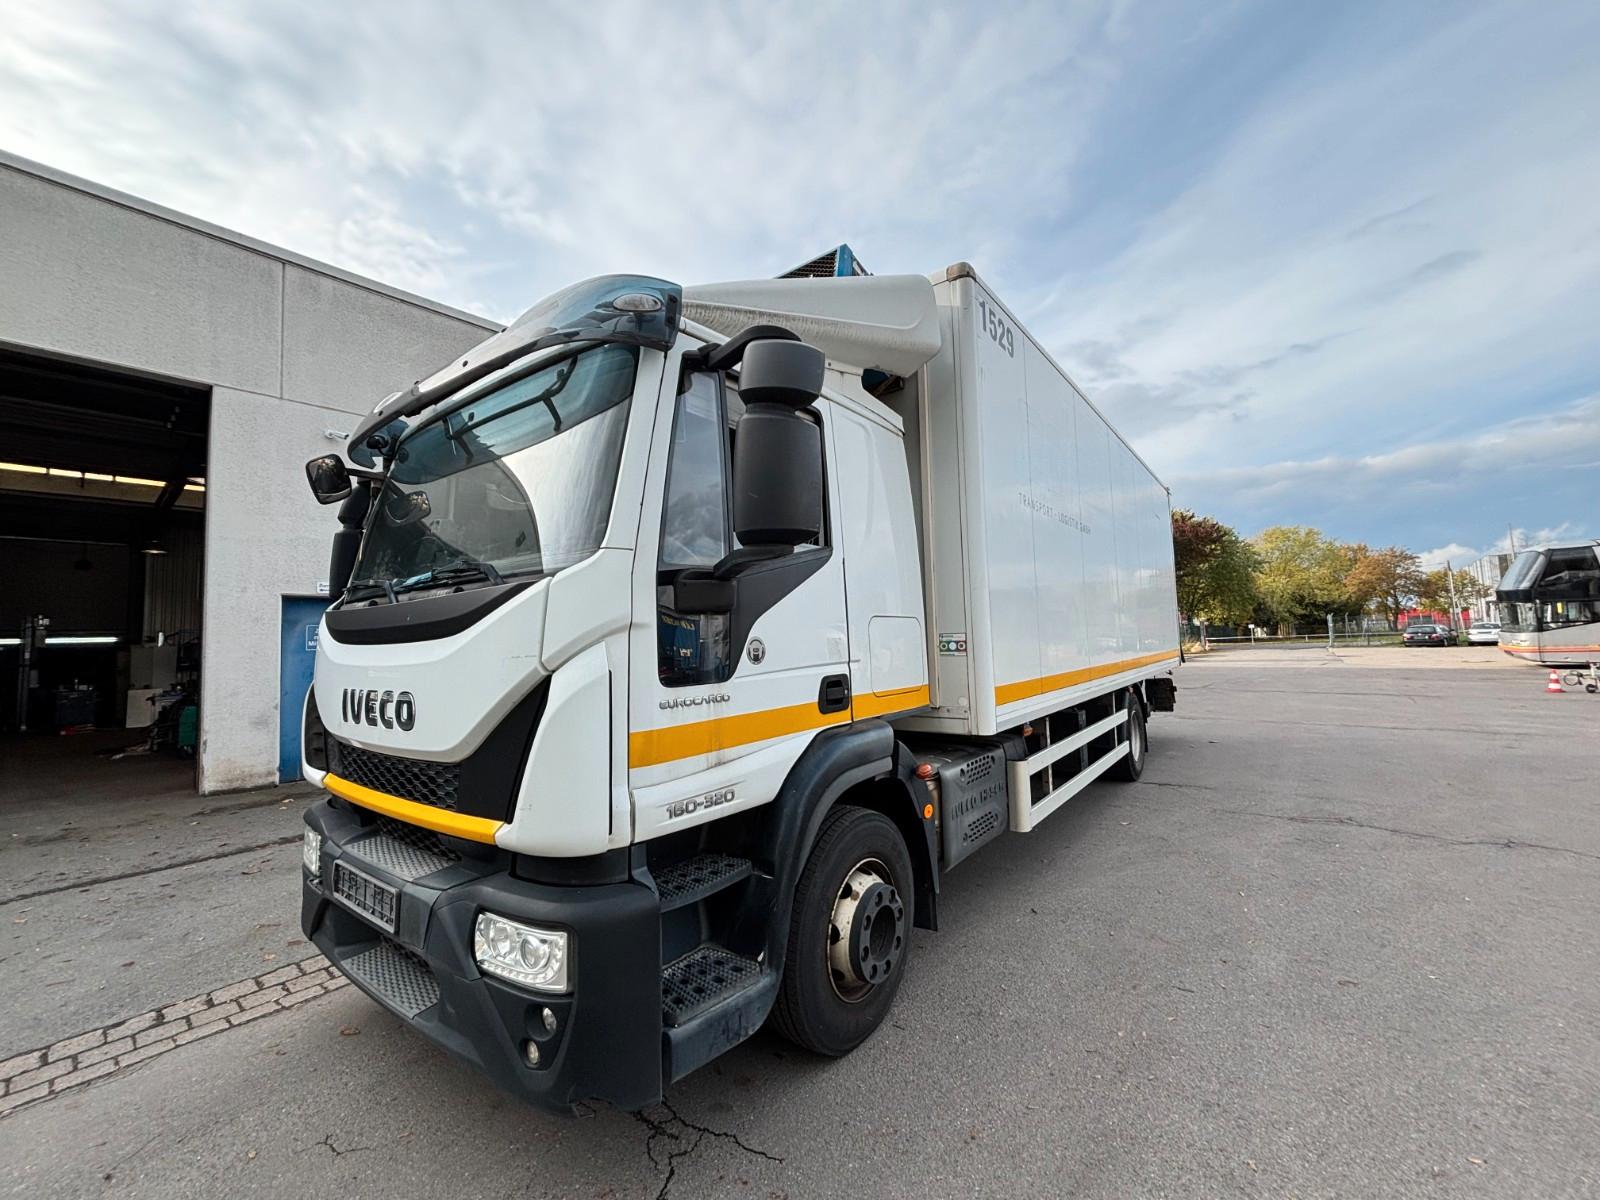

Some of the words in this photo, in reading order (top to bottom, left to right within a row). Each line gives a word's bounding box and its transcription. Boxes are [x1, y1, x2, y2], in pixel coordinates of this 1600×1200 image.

[979, 300, 1014, 358] 1529
[342, 688, 416, 731] IVECO
[659, 693, 731, 710] EUROCARGO
[666, 788, 736, 819] 160-320
